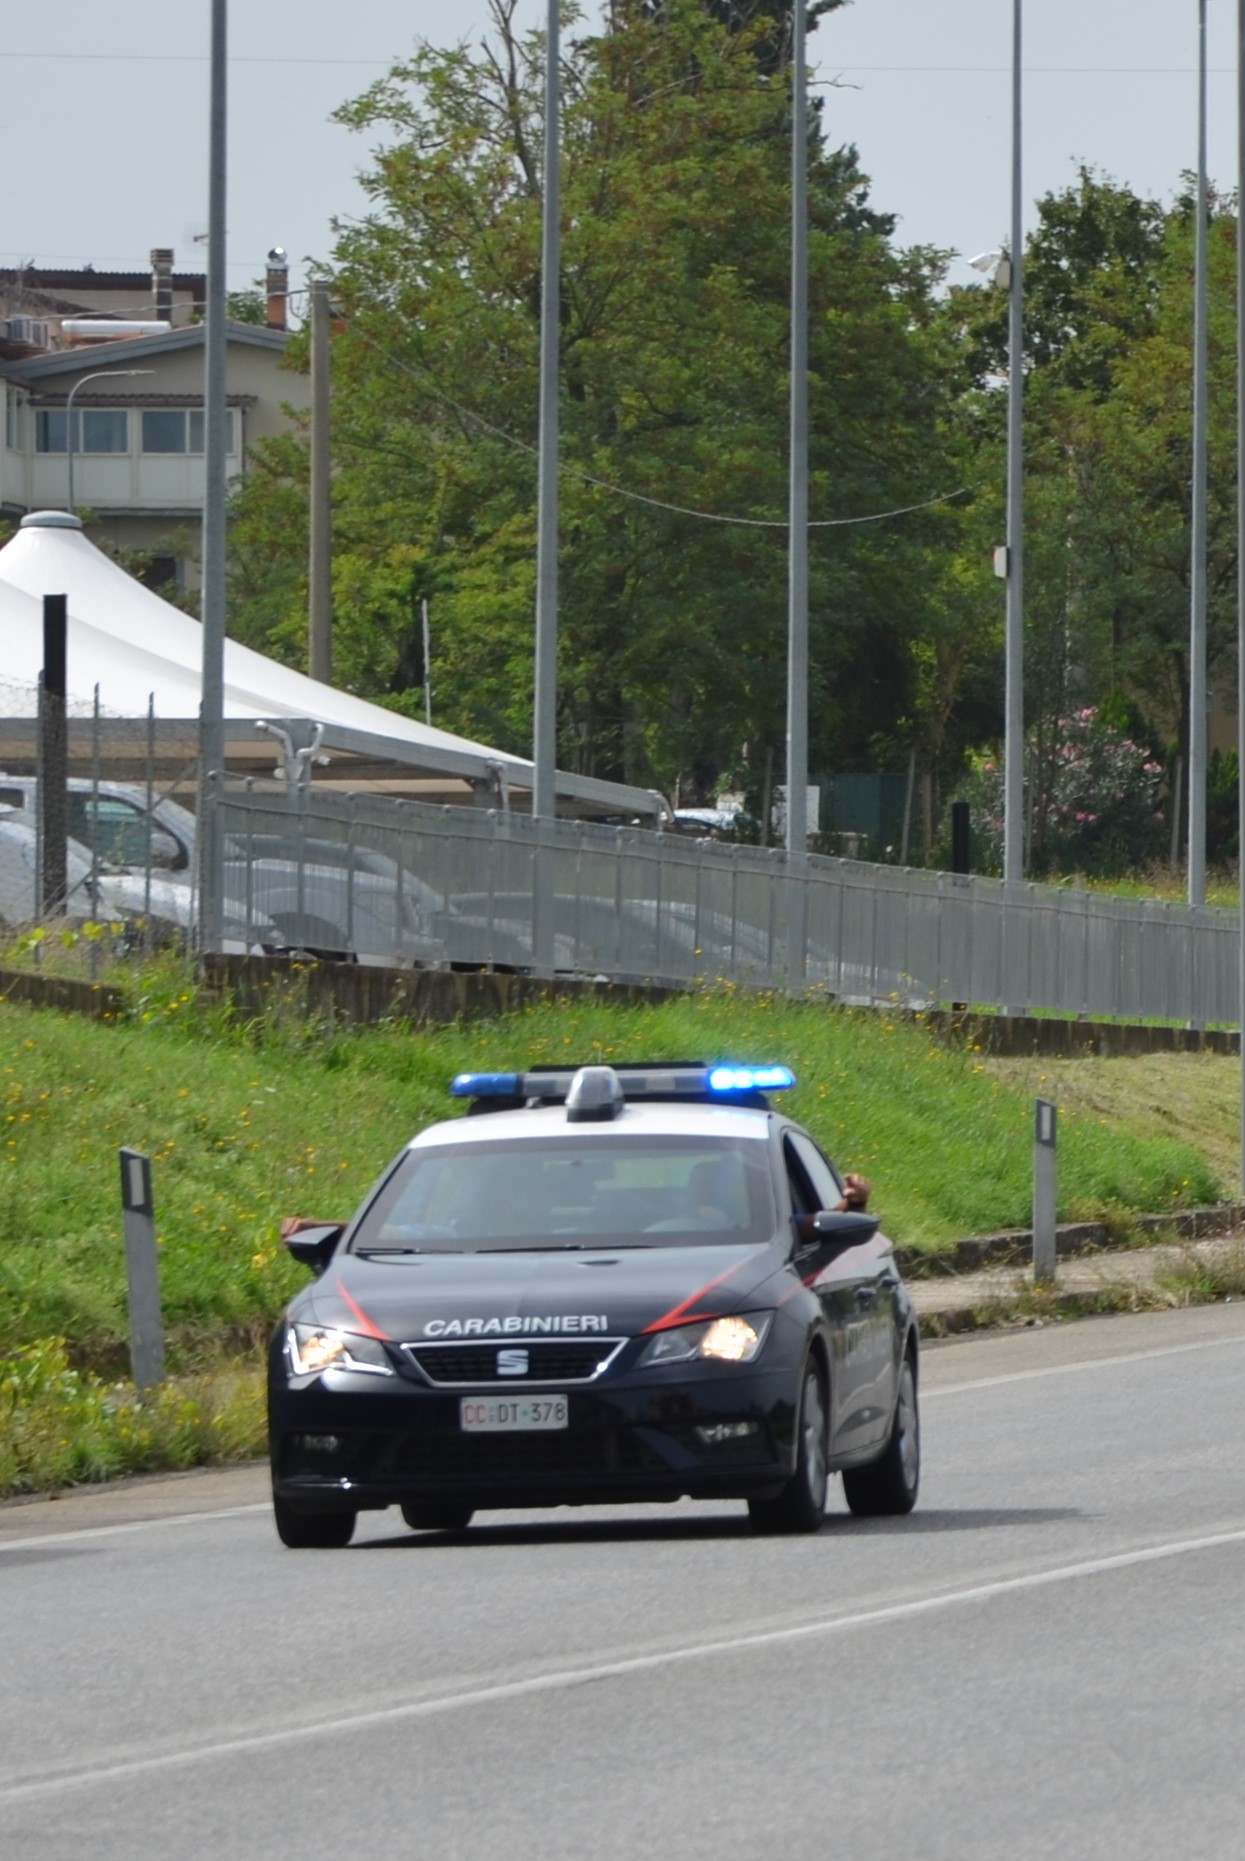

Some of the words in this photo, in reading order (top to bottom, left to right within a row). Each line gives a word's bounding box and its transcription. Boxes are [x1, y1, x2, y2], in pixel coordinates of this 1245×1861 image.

[423, 1315, 608, 1337] CARABINIERI
[464, 1404, 486, 1424] CC
[498, 1403, 520, 1422] DT
[531, 1402, 566, 1422] 378
